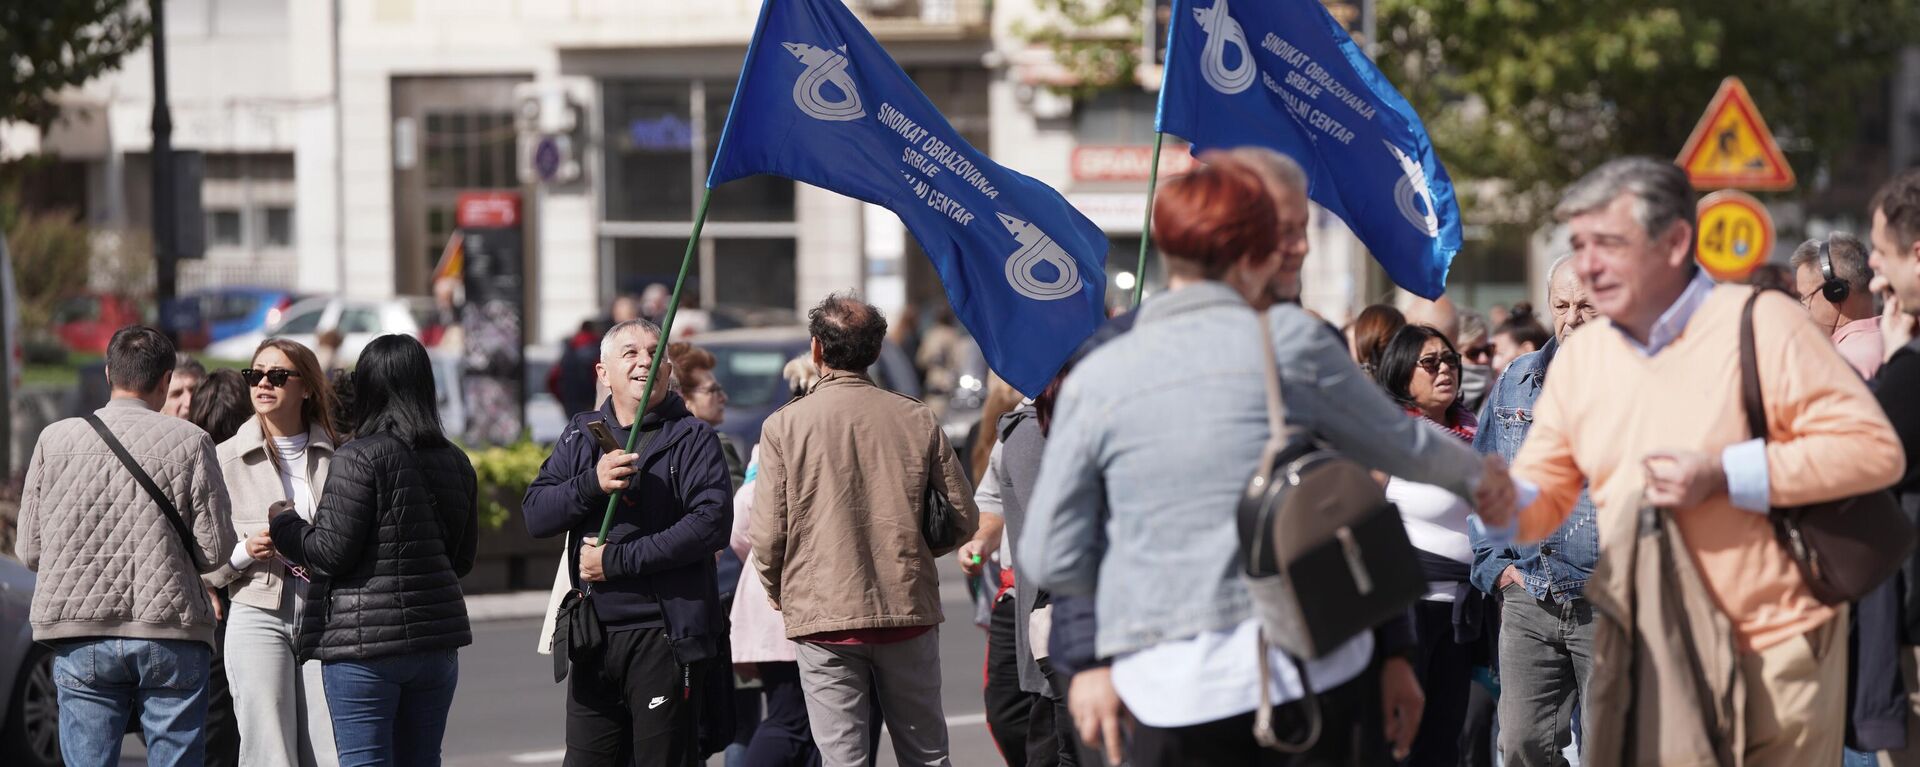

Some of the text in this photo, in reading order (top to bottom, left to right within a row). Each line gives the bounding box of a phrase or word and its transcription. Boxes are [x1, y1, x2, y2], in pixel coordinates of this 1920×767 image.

[1261, 32, 1376, 120] SINDIKAT OBRAZOVANJA
[1285, 70, 1322, 99] SRBIJE
[1309, 109, 1355, 145] CENTAR
[877, 102, 929, 144] SINDIKAT
[922, 136, 1000, 200] OBRAZOVANJA
[902, 146, 941, 178] SRBIJE
[927, 189, 975, 226] CENTAR
[1704, 218, 1754, 255] 40
